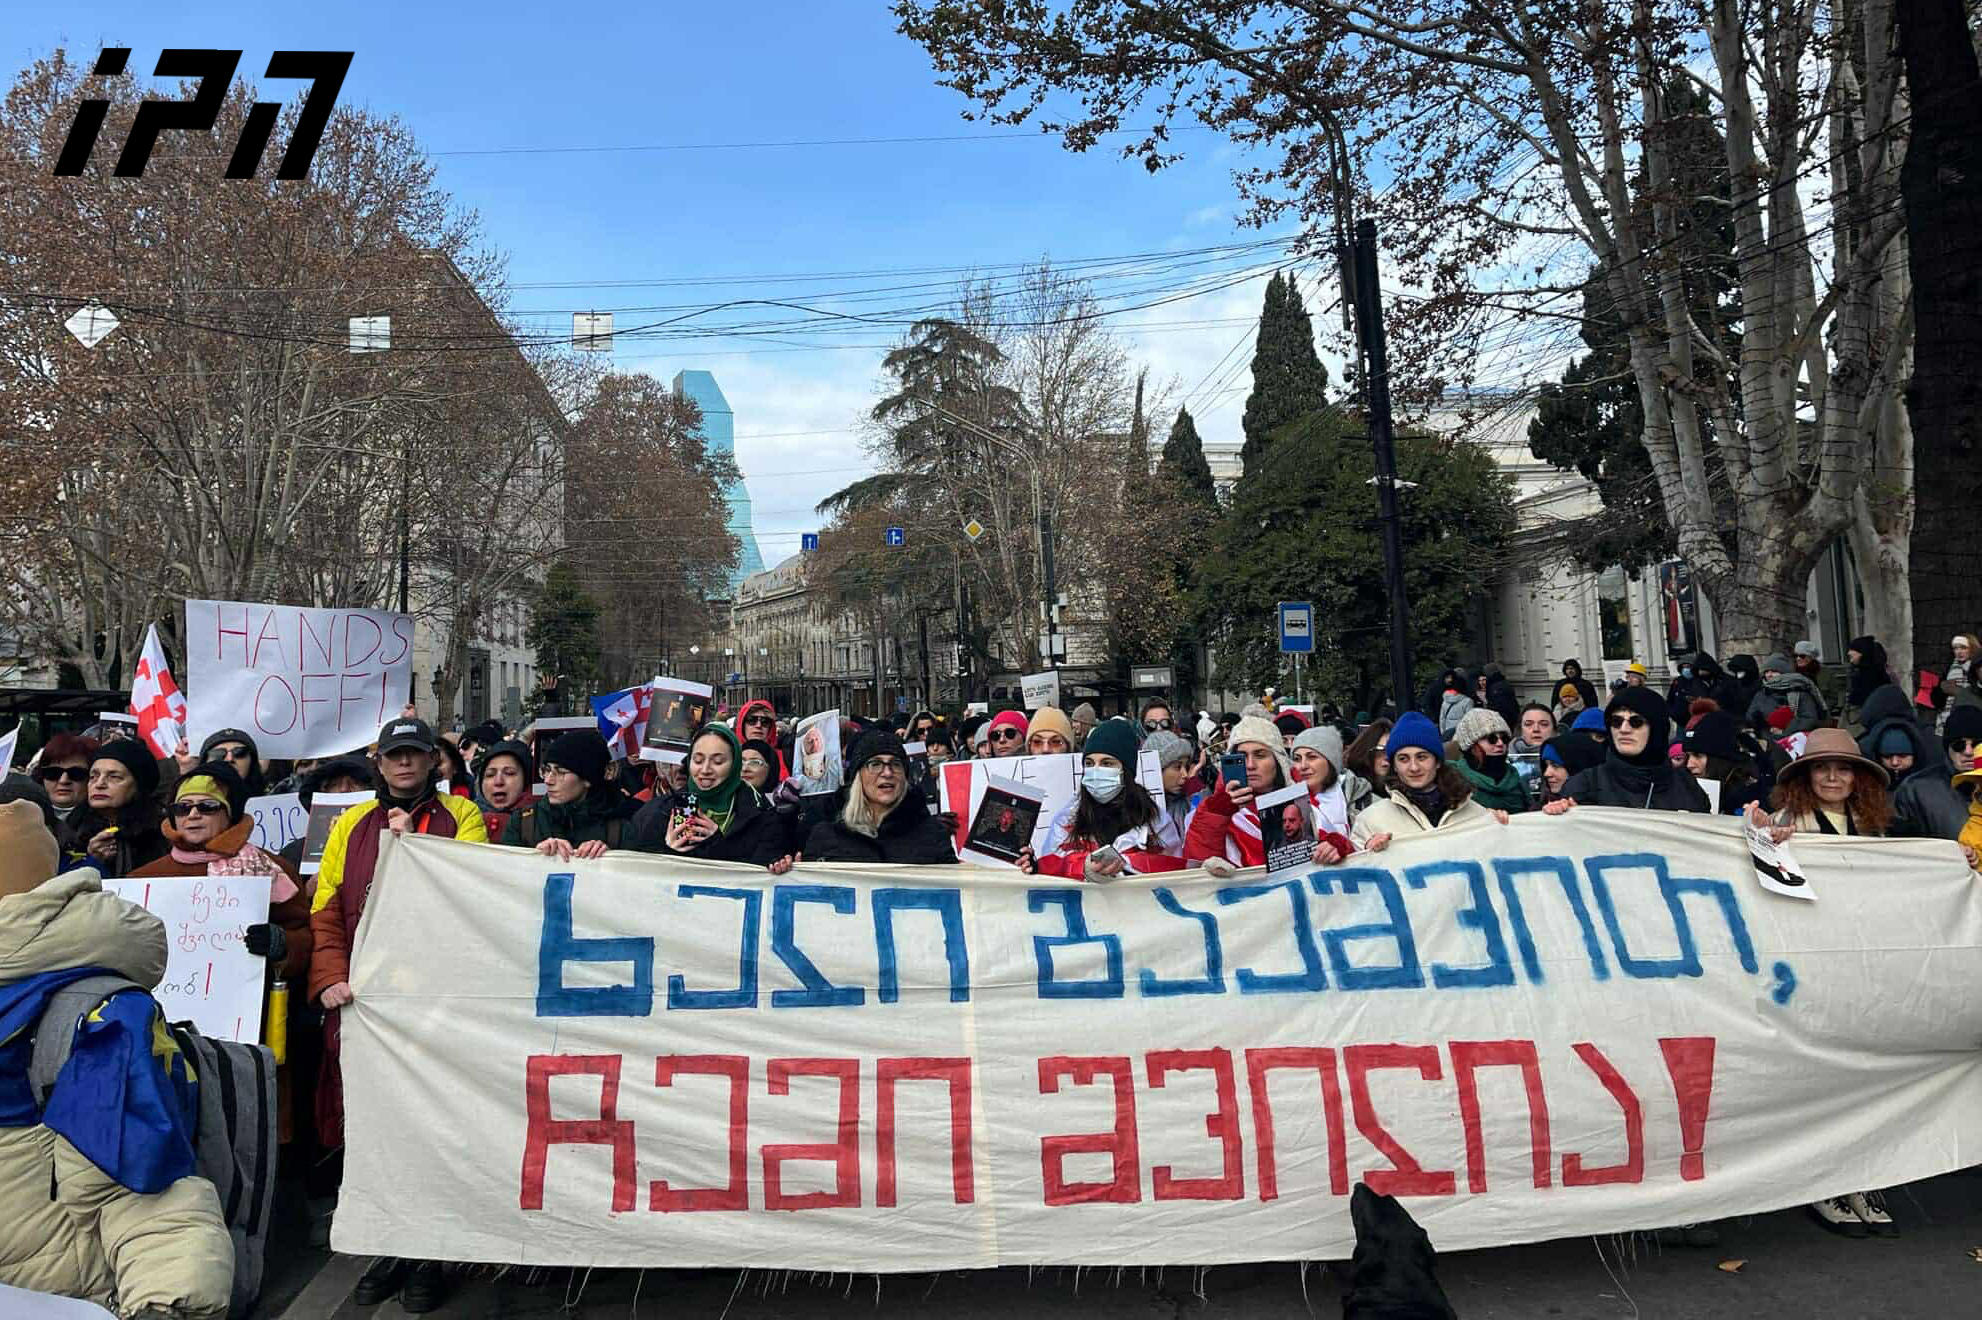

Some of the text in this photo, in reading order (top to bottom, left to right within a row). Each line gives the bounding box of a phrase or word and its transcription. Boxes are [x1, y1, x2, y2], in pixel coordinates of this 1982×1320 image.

[217, 604, 413, 671] HANDS
[254, 671, 388, 735] OFF!
[191, 882, 239, 923] ჩემი
[536, 853, 1796, 1016] ხელი გაუშვით,
[520, 1037, 1716, 1212] ჩემი შვილია!
